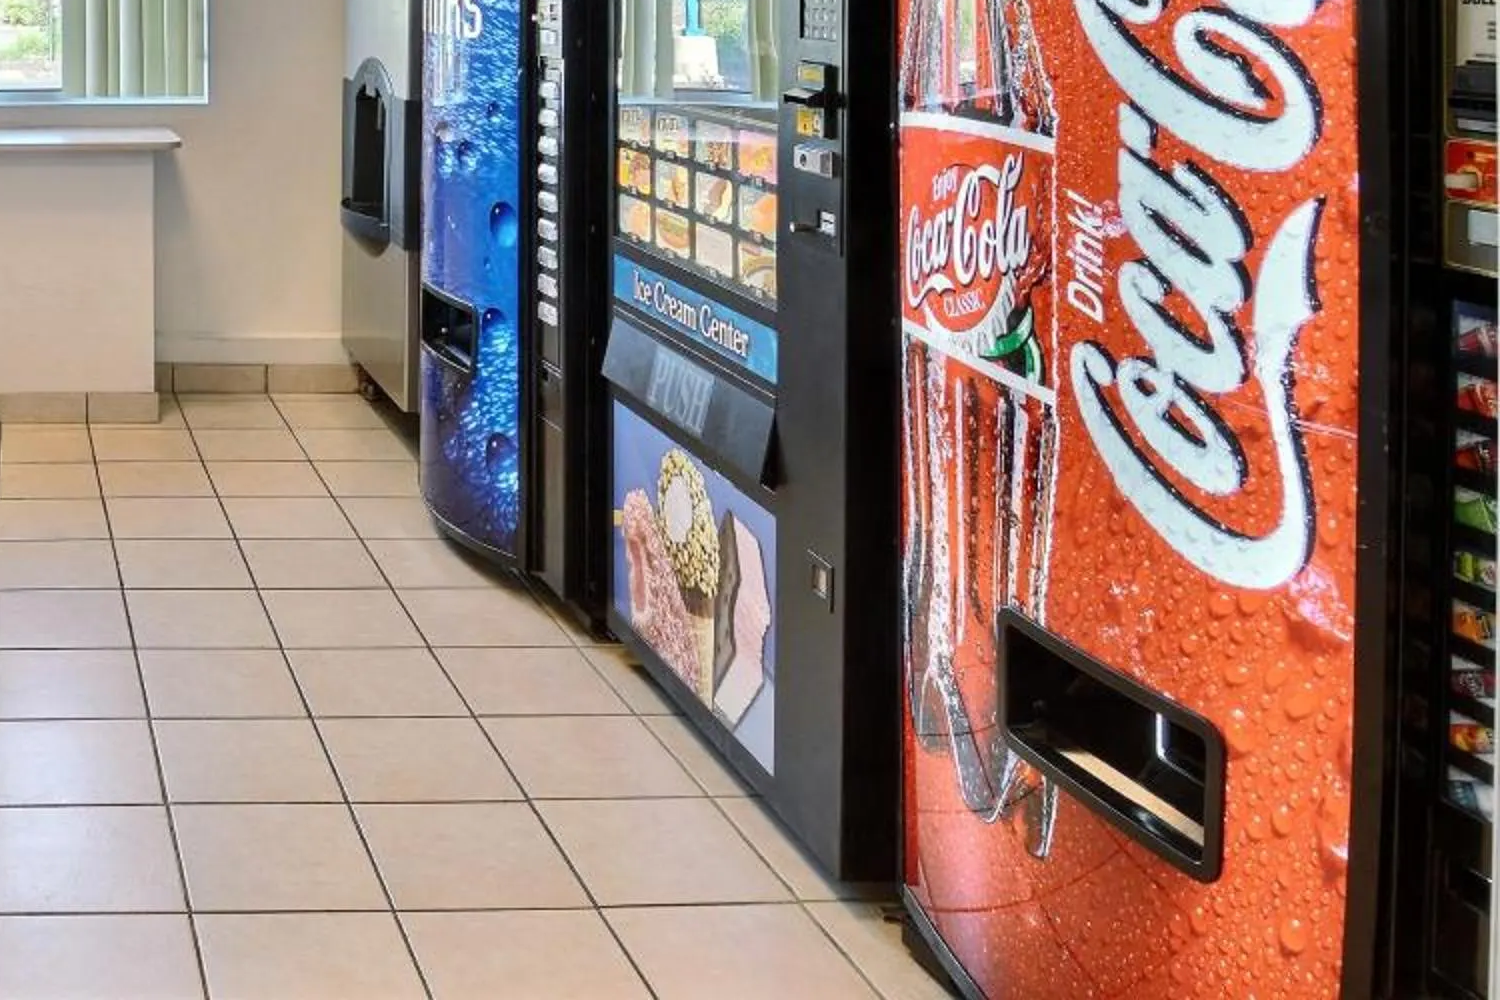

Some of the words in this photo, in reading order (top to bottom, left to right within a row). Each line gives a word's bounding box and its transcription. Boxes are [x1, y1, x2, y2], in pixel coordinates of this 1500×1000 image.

[907, 152, 1030, 308] Coca-Cola
[1062, 188, 1104, 323] Drink!
[633, 268, 653, 305] Ice
[653, 281, 698, 332] Cream
[701, 304, 749, 358] Center
[650, 353, 714, 434] PUSH
